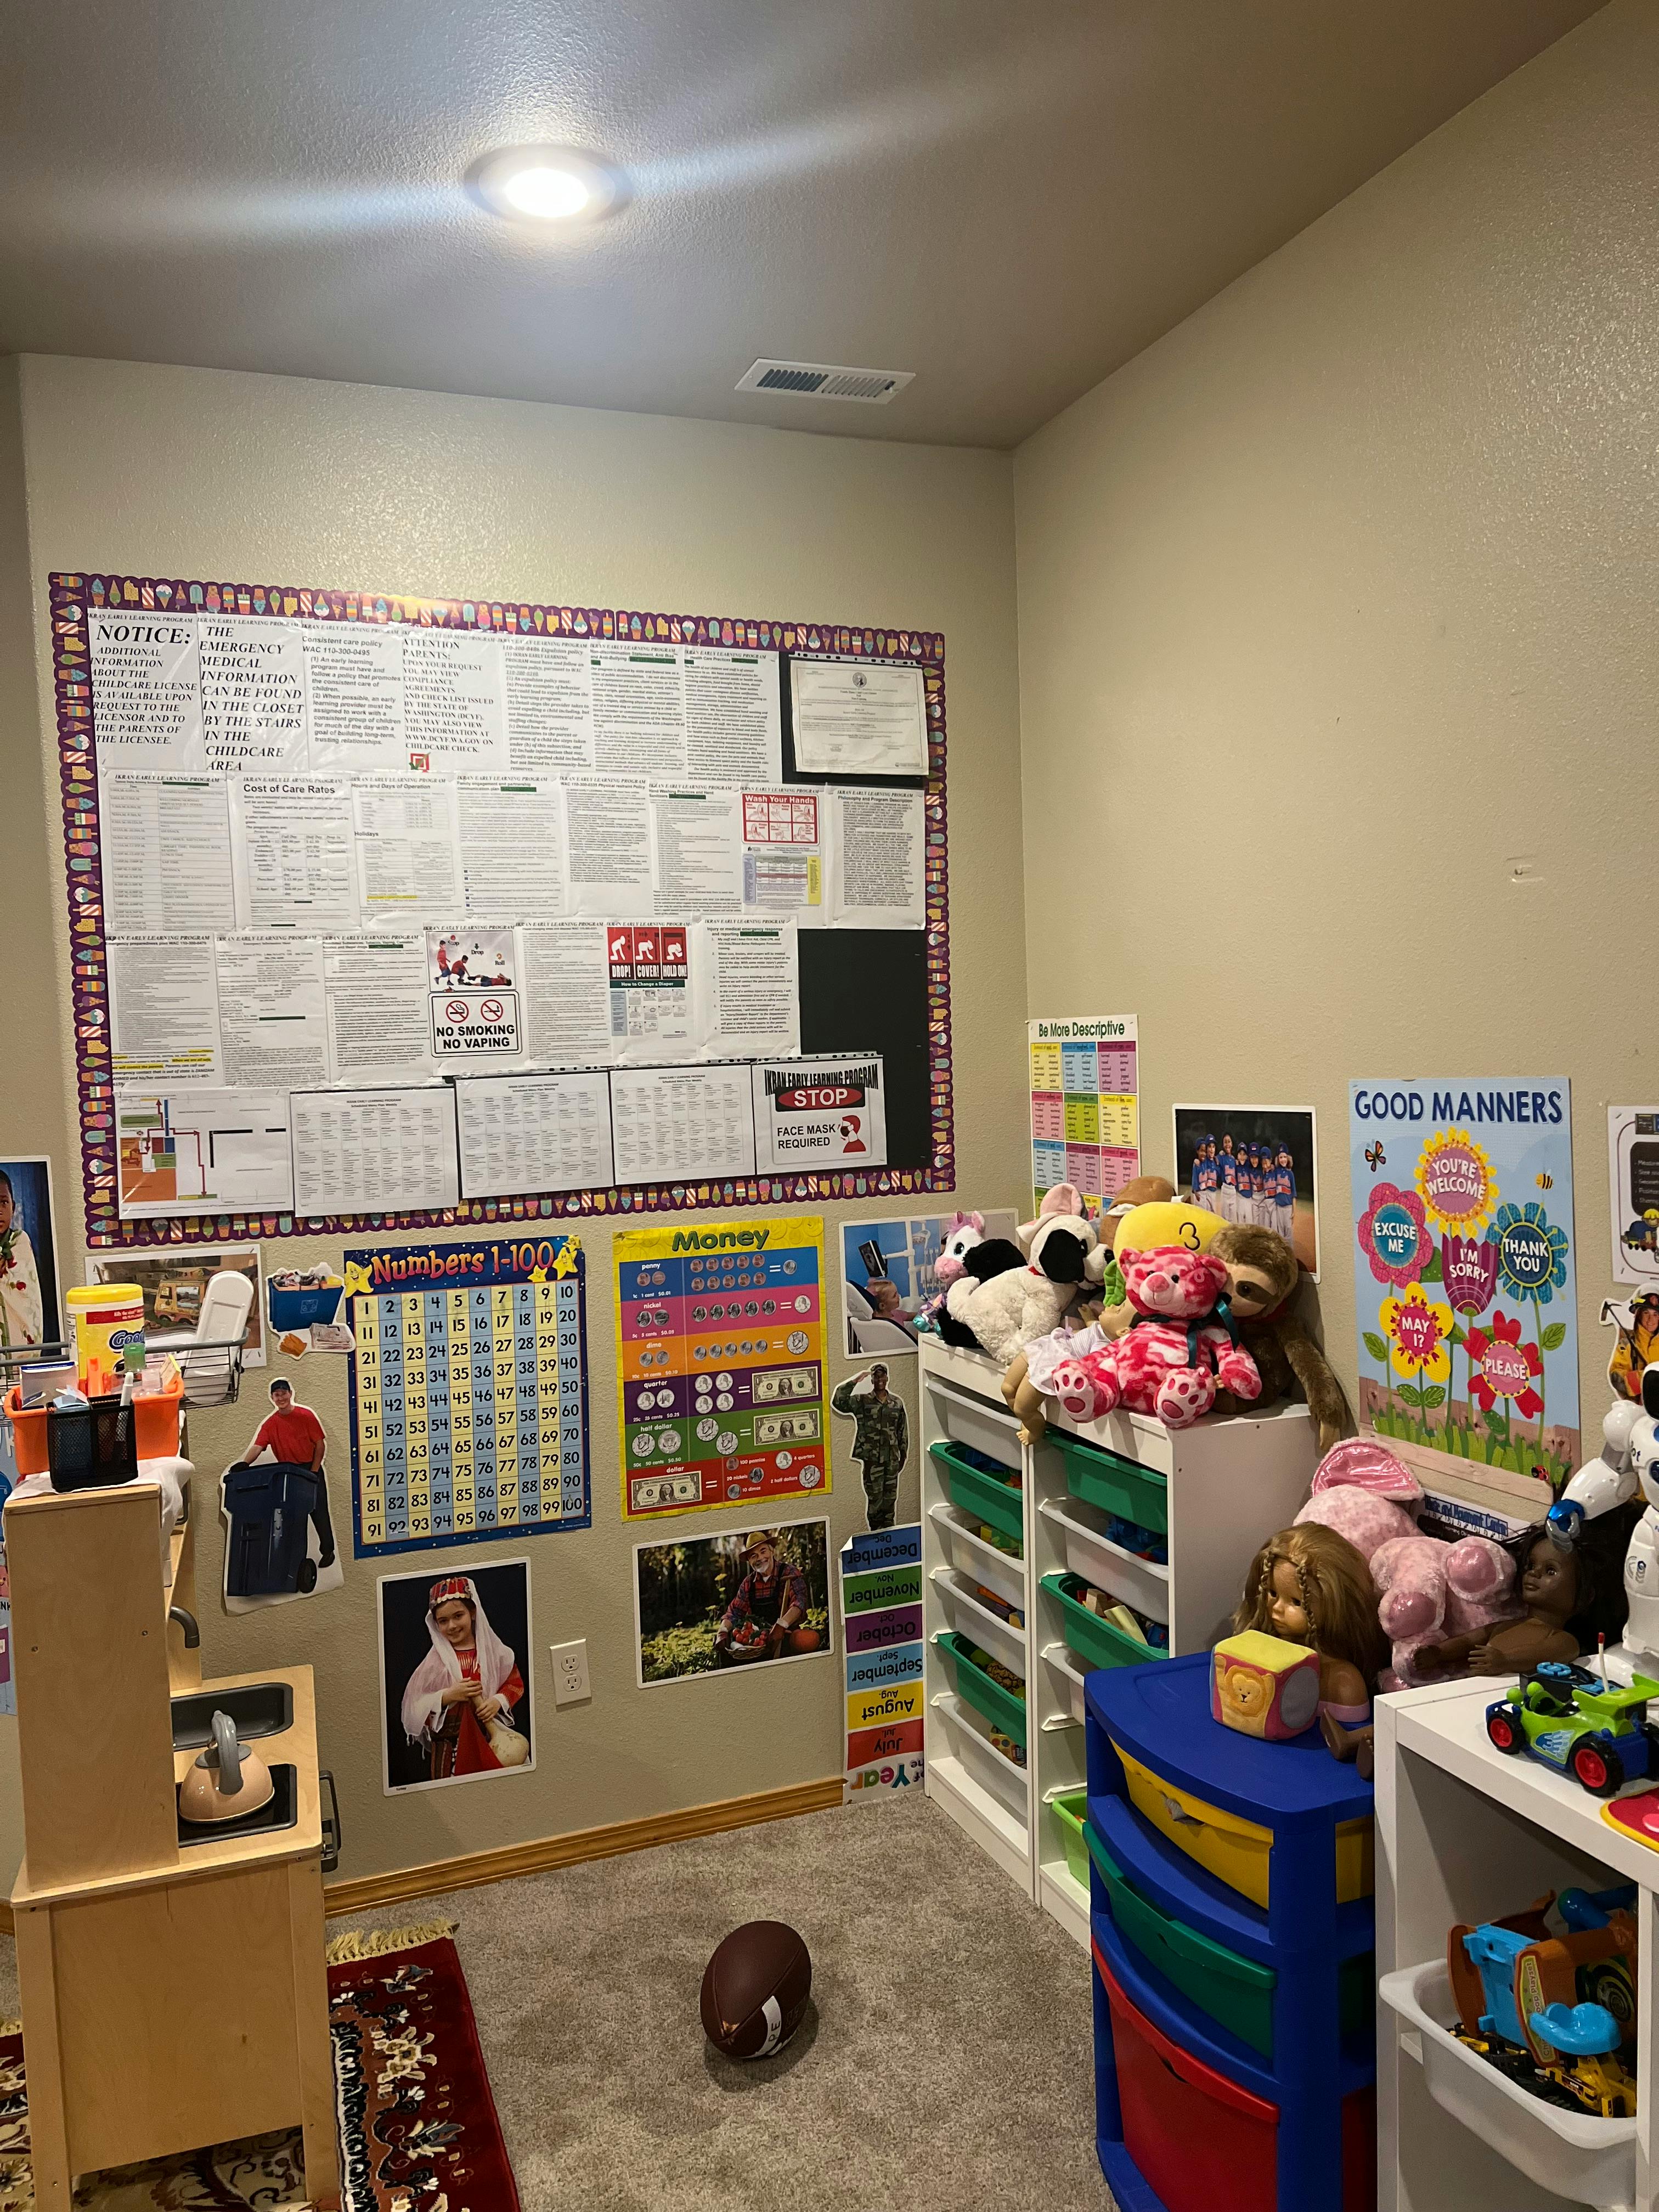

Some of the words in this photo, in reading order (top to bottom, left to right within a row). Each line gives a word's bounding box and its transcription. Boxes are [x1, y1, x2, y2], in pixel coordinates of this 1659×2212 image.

[97, 625, 190, 644] NOTICE:
[207, 627, 234, 636] THE
[200, 641, 284, 654] EMERGENCY
[404, 639, 459, 649] ATTENTION
[97, 647, 161, 656] ADDITIONAL
[403, 649, 450, 659] PARENTS:
[91, 658, 163, 667] INFORMATION
[200, 656, 262, 668] MEDICAL
[449, 663, 482, 671] REQUEST
[201, 671, 297, 684] INFORMATION
[404, 676, 454, 685] COMPLIANCE
[93, 680, 151, 689] CHILDCARE
[105, 692, 162, 700] AVAILABLE
[202, 686, 229, 696] CAN
[234, 687, 251, 697] BE
[256, 689, 301, 698] FOUND
[94, 702, 141, 711] REQUEST
[204, 701, 218, 710] IN
[223, 702, 249, 711] THE
[253, 703, 304, 713] CLOSET
[94, 713, 145, 721] LICENSOR
[205, 716, 222, 725] BY
[225, 716, 252, 726] THE
[256, 718, 301, 728] STAIRS
[119, 725, 164, 733] PARENTS
[205, 731, 219, 740] IN
[224, 731, 251, 741] THE
[206, 746, 284, 757] CHILDCARE
[206, 761, 241, 770] AREA
[612, 966, 630, 977] DROP!
[637, 965, 659, 977] COVER!
[663, 965, 676, 977] HOLD
[678, 965, 687, 977] ON!
[437, 1027, 453, 1036] NO
[458, 1025, 515, 1036] SMOKING
[1039, 1024, 1048, 1037] Be
[1051, 1023, 1069, 1037] More
[1073, 1021, 1125, 1039] Descriptive
[443, 1040, 460, 1049] NO
[465, 1037, 510, 1048] VAPING
[765, 1069, 786, 1096] IKRAN
[788, 1073, 808, 1087] EARLY
[810, 1071, 843, 1086] LEARNING
[844, 1063, 878, 1090] PROGRAM
[794, 1088, 848, 1107] STOP
[1355, 1091, 1424, 1119] GOOD
[1432, 1091, 1562, 1123] MANNERS
[777, 1126, 804, 1136] FACE
[807, 1124, 836, 1134] MASK
[778, 1137, 830, 1149] REQUIRED
[1432, 1159, 1477, 1178] YOU'RE
[1426, 1177, 1487, 1200] WELCOME
[1179, 1222, 1200, 1251] 3
[1374, 1222, 1417, 1240] EXCUSE
[672, 1229, 769, 1251] Money
[1388, 1239, 1404, 1253] ME
[1504, 1239, 1549, 1257] THANK
[371, 1250, 484, 1284] Numbers
[492, 1242, 554, 1273] 1-100
[1460, 1249, 1478, 1264] I'M
[1514, 1256, 1539, 1272] YOU
[1449, 1263, 1489, 1283] SORRY
[365, 1302, 368, 1314] 1
[386, 1300, 394, 1312] 2
[410, 1299, 417, 1311] 3
[432, 1297, 439, 1308] 4
[455, 1295, 462, 1307] 5
[476, 1293, 484, 1305] 6
[499, 1292, 506, 1303] 7
[521, 1290, 528, 1301] 8
[541, 1288, 549, 1299] 9
[561, 1286, 573, 1298] 10
[1402, 1317, 1430, 1333] MAY
[1413, 1334, 1424, 1347] I?
[1486, 1358, 1526, 1380] PLEASE
[848, 1543, 917, 1565] December
[875, 1574, 894, 1582] Nov.
[849, 1581, 919, 1604] November
[856, 1622, 916, 1642] October
[877, 1651, 898, 1662] Sept.
[852, 1658, 922, 1682] September
[879, 1690, 898, 1699] Aug.
[862, 1699, 914, 1720] August
[874, 1738, 904, 1754] July
[851, 1764, 910, 1790] Year
[1526, 1962, 1537, 1994] Playset
